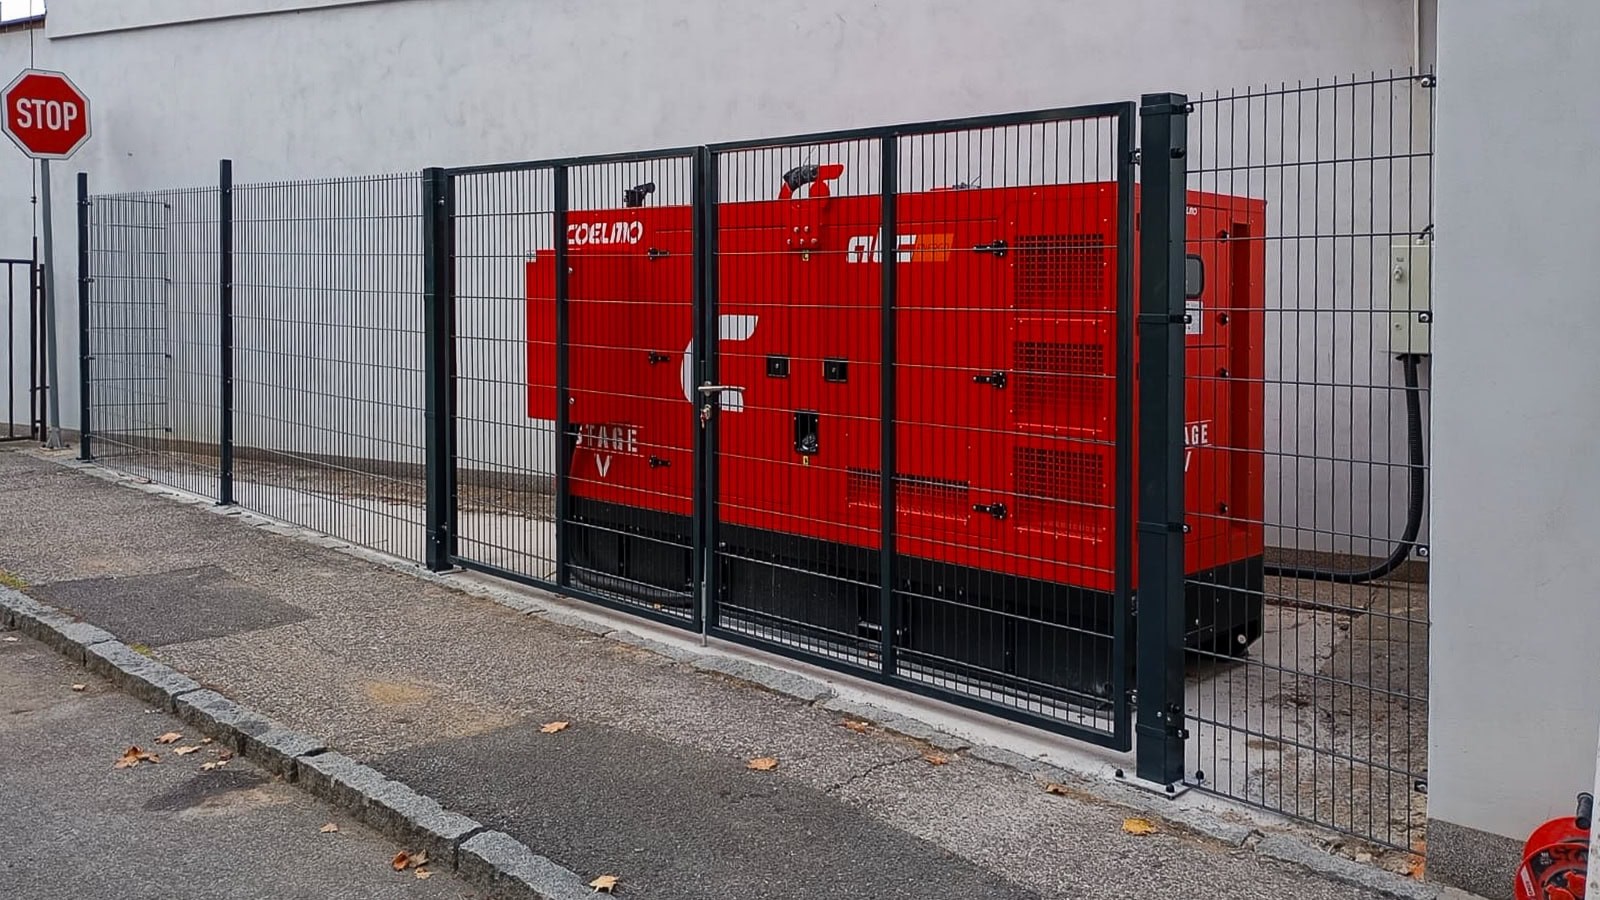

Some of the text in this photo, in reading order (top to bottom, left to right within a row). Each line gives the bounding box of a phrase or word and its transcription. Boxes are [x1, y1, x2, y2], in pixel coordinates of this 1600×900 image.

[16, 97, 77, 131] STOP
[567, 221, 643, 245] COELMO
[1184, 424, 1208, 445] AGE
[594, 453, 612, 478] V
